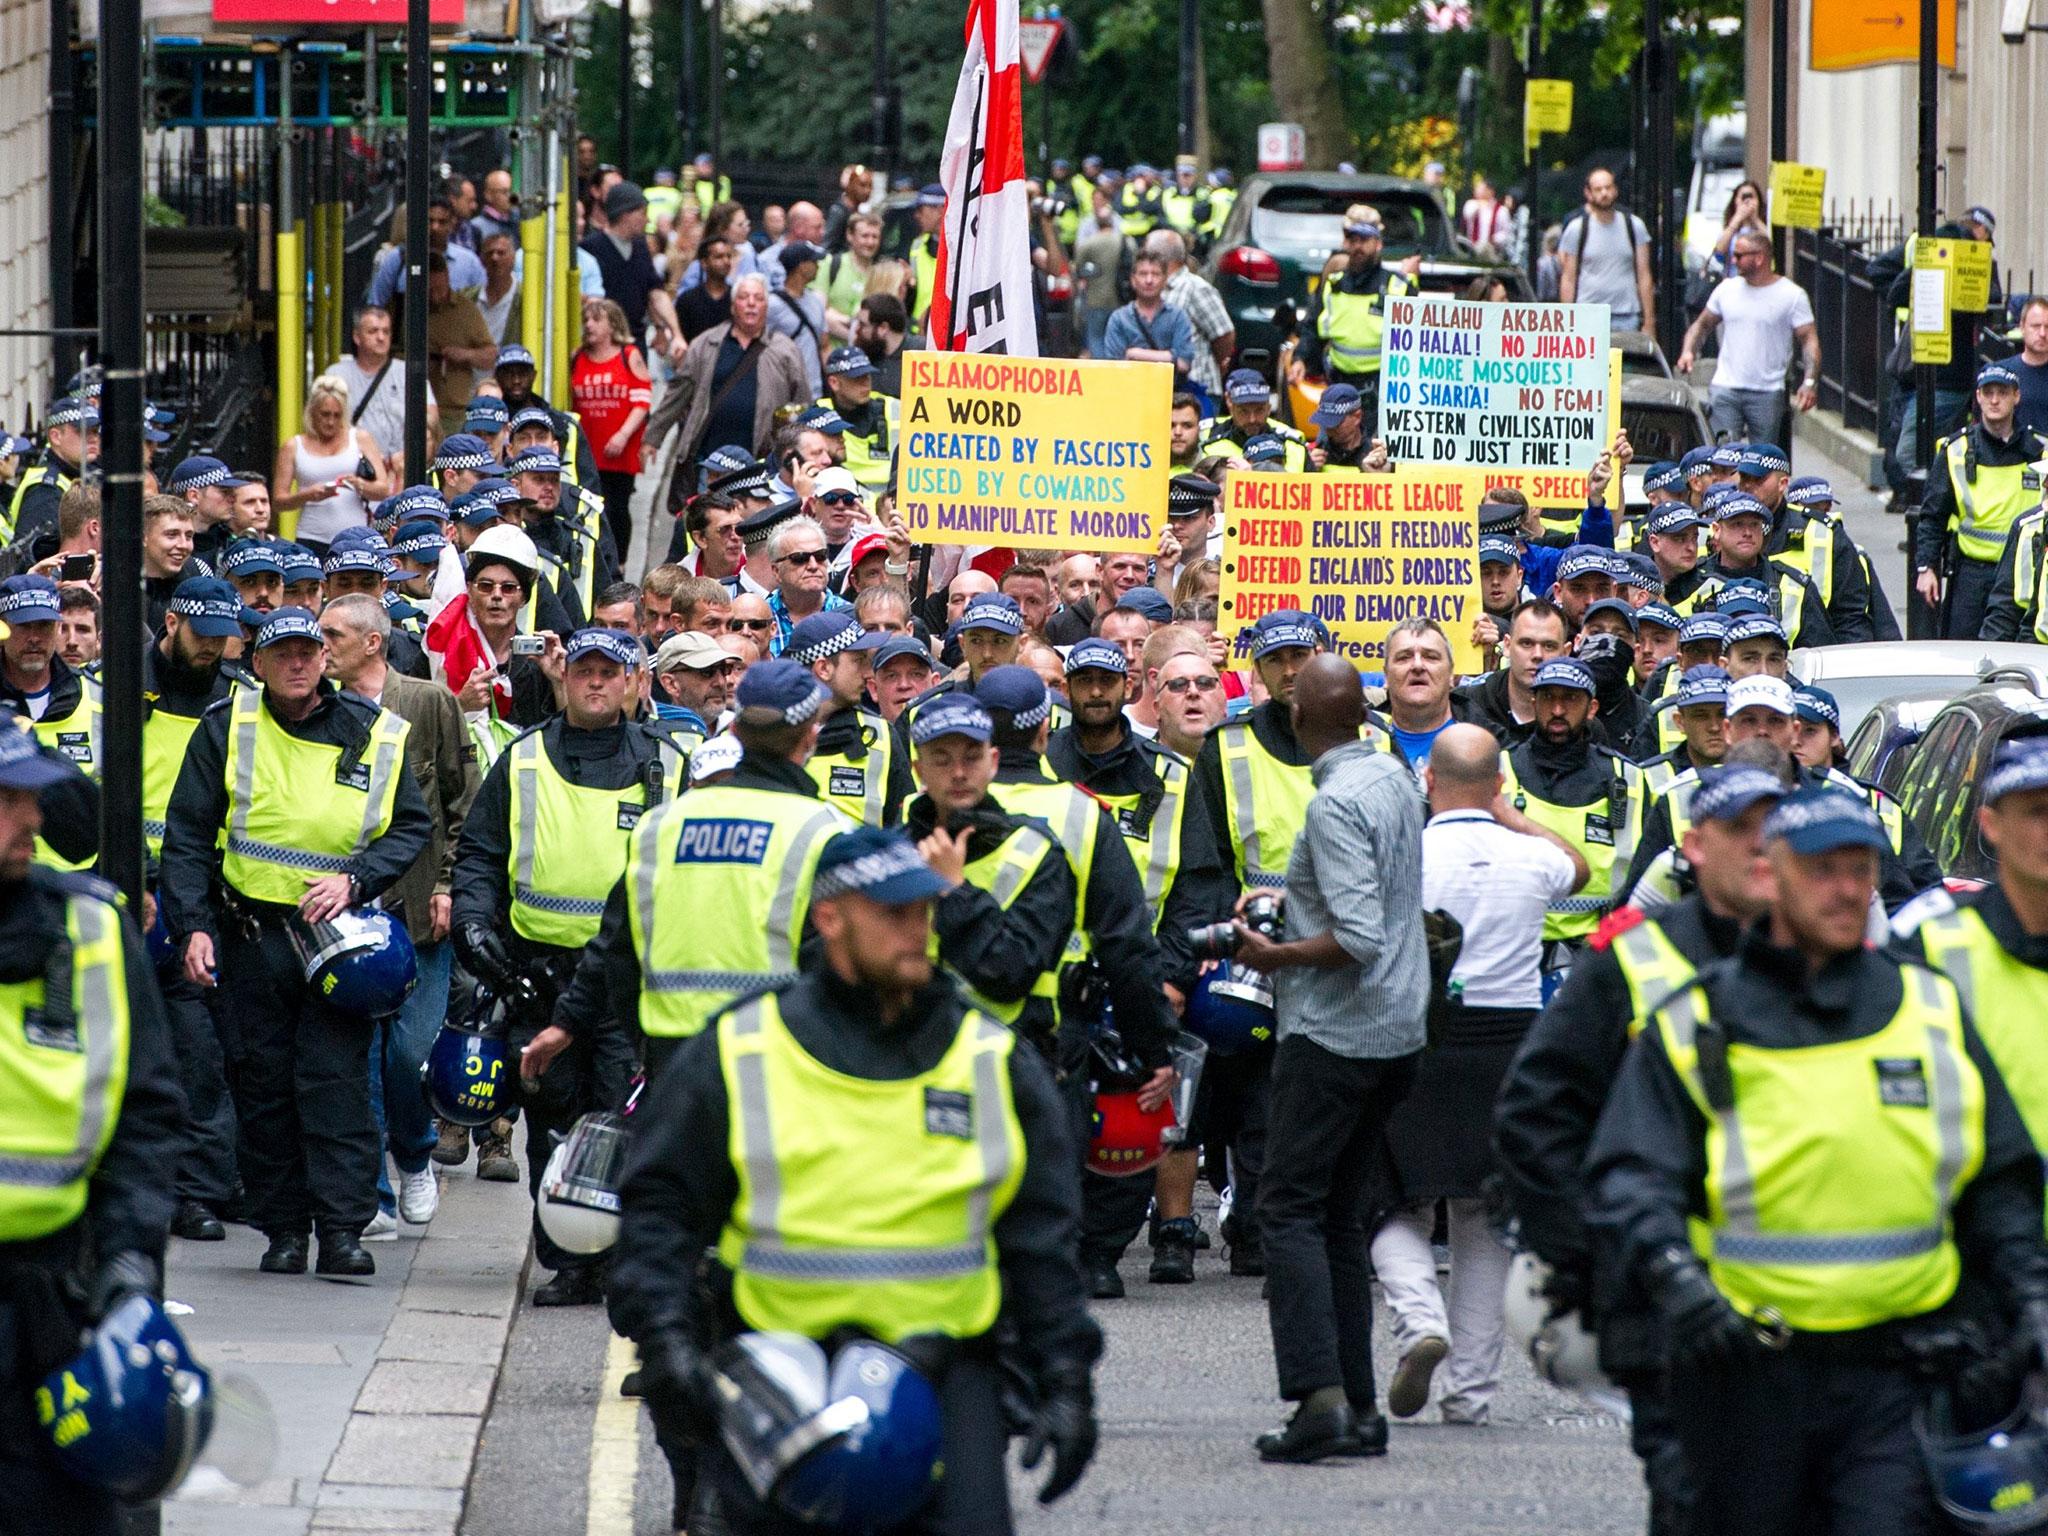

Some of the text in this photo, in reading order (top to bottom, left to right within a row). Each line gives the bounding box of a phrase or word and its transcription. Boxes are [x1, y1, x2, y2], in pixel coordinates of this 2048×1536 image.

[1391, 302, 1414, 325] NO
[1421, 304, 1483, 330] ALLAHU
[1390, 328, 1595, 360] NO HALAL! NO JIHAD!
[910, 361, 1083, 396] ISLAMOPHOBIA
[1388, 354, 1573, 386] NO MORE MOSQUES!
[1386, 381, 1411, 404] NO
[1519, 388, 1545, 411] NO
[910, 396, 1022, 428] A WORD
[1386, 408, 1594, 440] WESTERN CIVILISATION
[909, 433, 1152, 469] CREATED BY FASCISTS
[1385, 434, 1424, 460] WILL
[1433, 438, 1456, 460] DO
[1465, 440, 1511, 464] JUST
[907, 468, 1125, 504] USED BY COWARDS
[1234, 481, 1464, 512] ENGLISH DEFENCE LEAGUE
[1533, 476, 1590, 499] SPEECH
[906, 503, 1152, 540] TO MANIPULATE MORONS
[1239, 519, 1473, 549] DEFEND ENGLISH FREEDOMS
[1237, 555, 1473, 585] DEFEND ENGLAND'S BORDERS
[1235, 592, 1465, 623] DEFEND OUR DEMOCRACY
[680, 824, 768, 858] POLICE
[470, 1081, 495, 1097] MP
